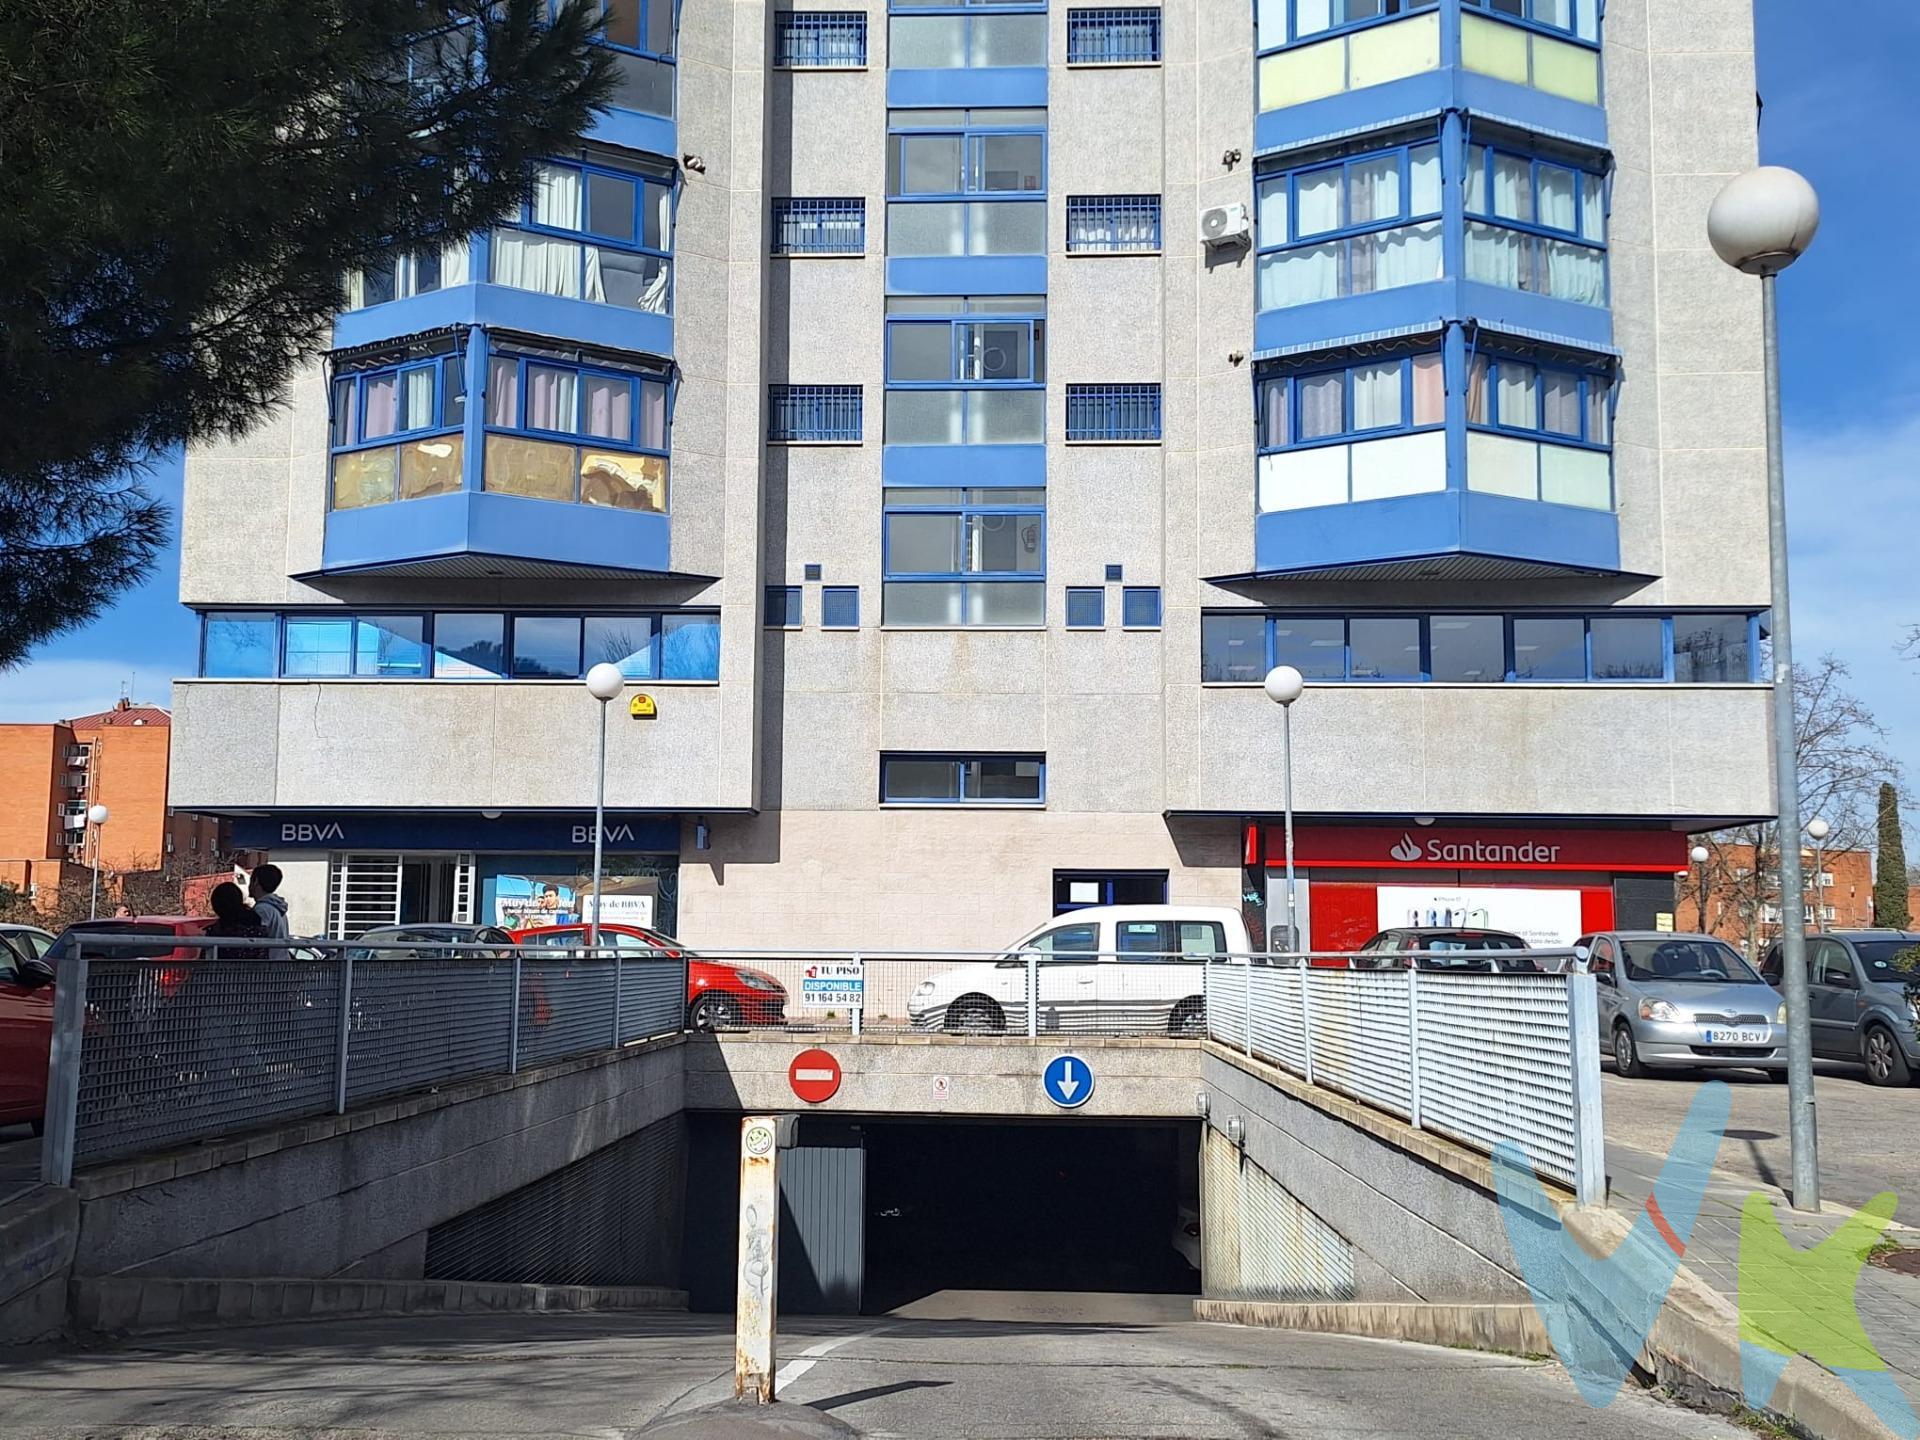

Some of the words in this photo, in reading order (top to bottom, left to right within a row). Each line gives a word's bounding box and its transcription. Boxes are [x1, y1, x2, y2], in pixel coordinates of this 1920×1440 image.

[281, 822, 345, 841] BBVA
[1427, 839, 1560, 862] Santander
[621, 900, 646, 908] BBVA
[821, 966, 833, 975] TU
[836, 966, 860, 975] PISO
[804, 981, 862, 991] DISPONIBLE
[805, 993, 815, 1002] 91
[818, 993, 833, 1002] 164
[836, 993, 848, 1002] 54
[849, 993, 861, 1003] 82
[1742, 1032, 1761, 1042] BCV
